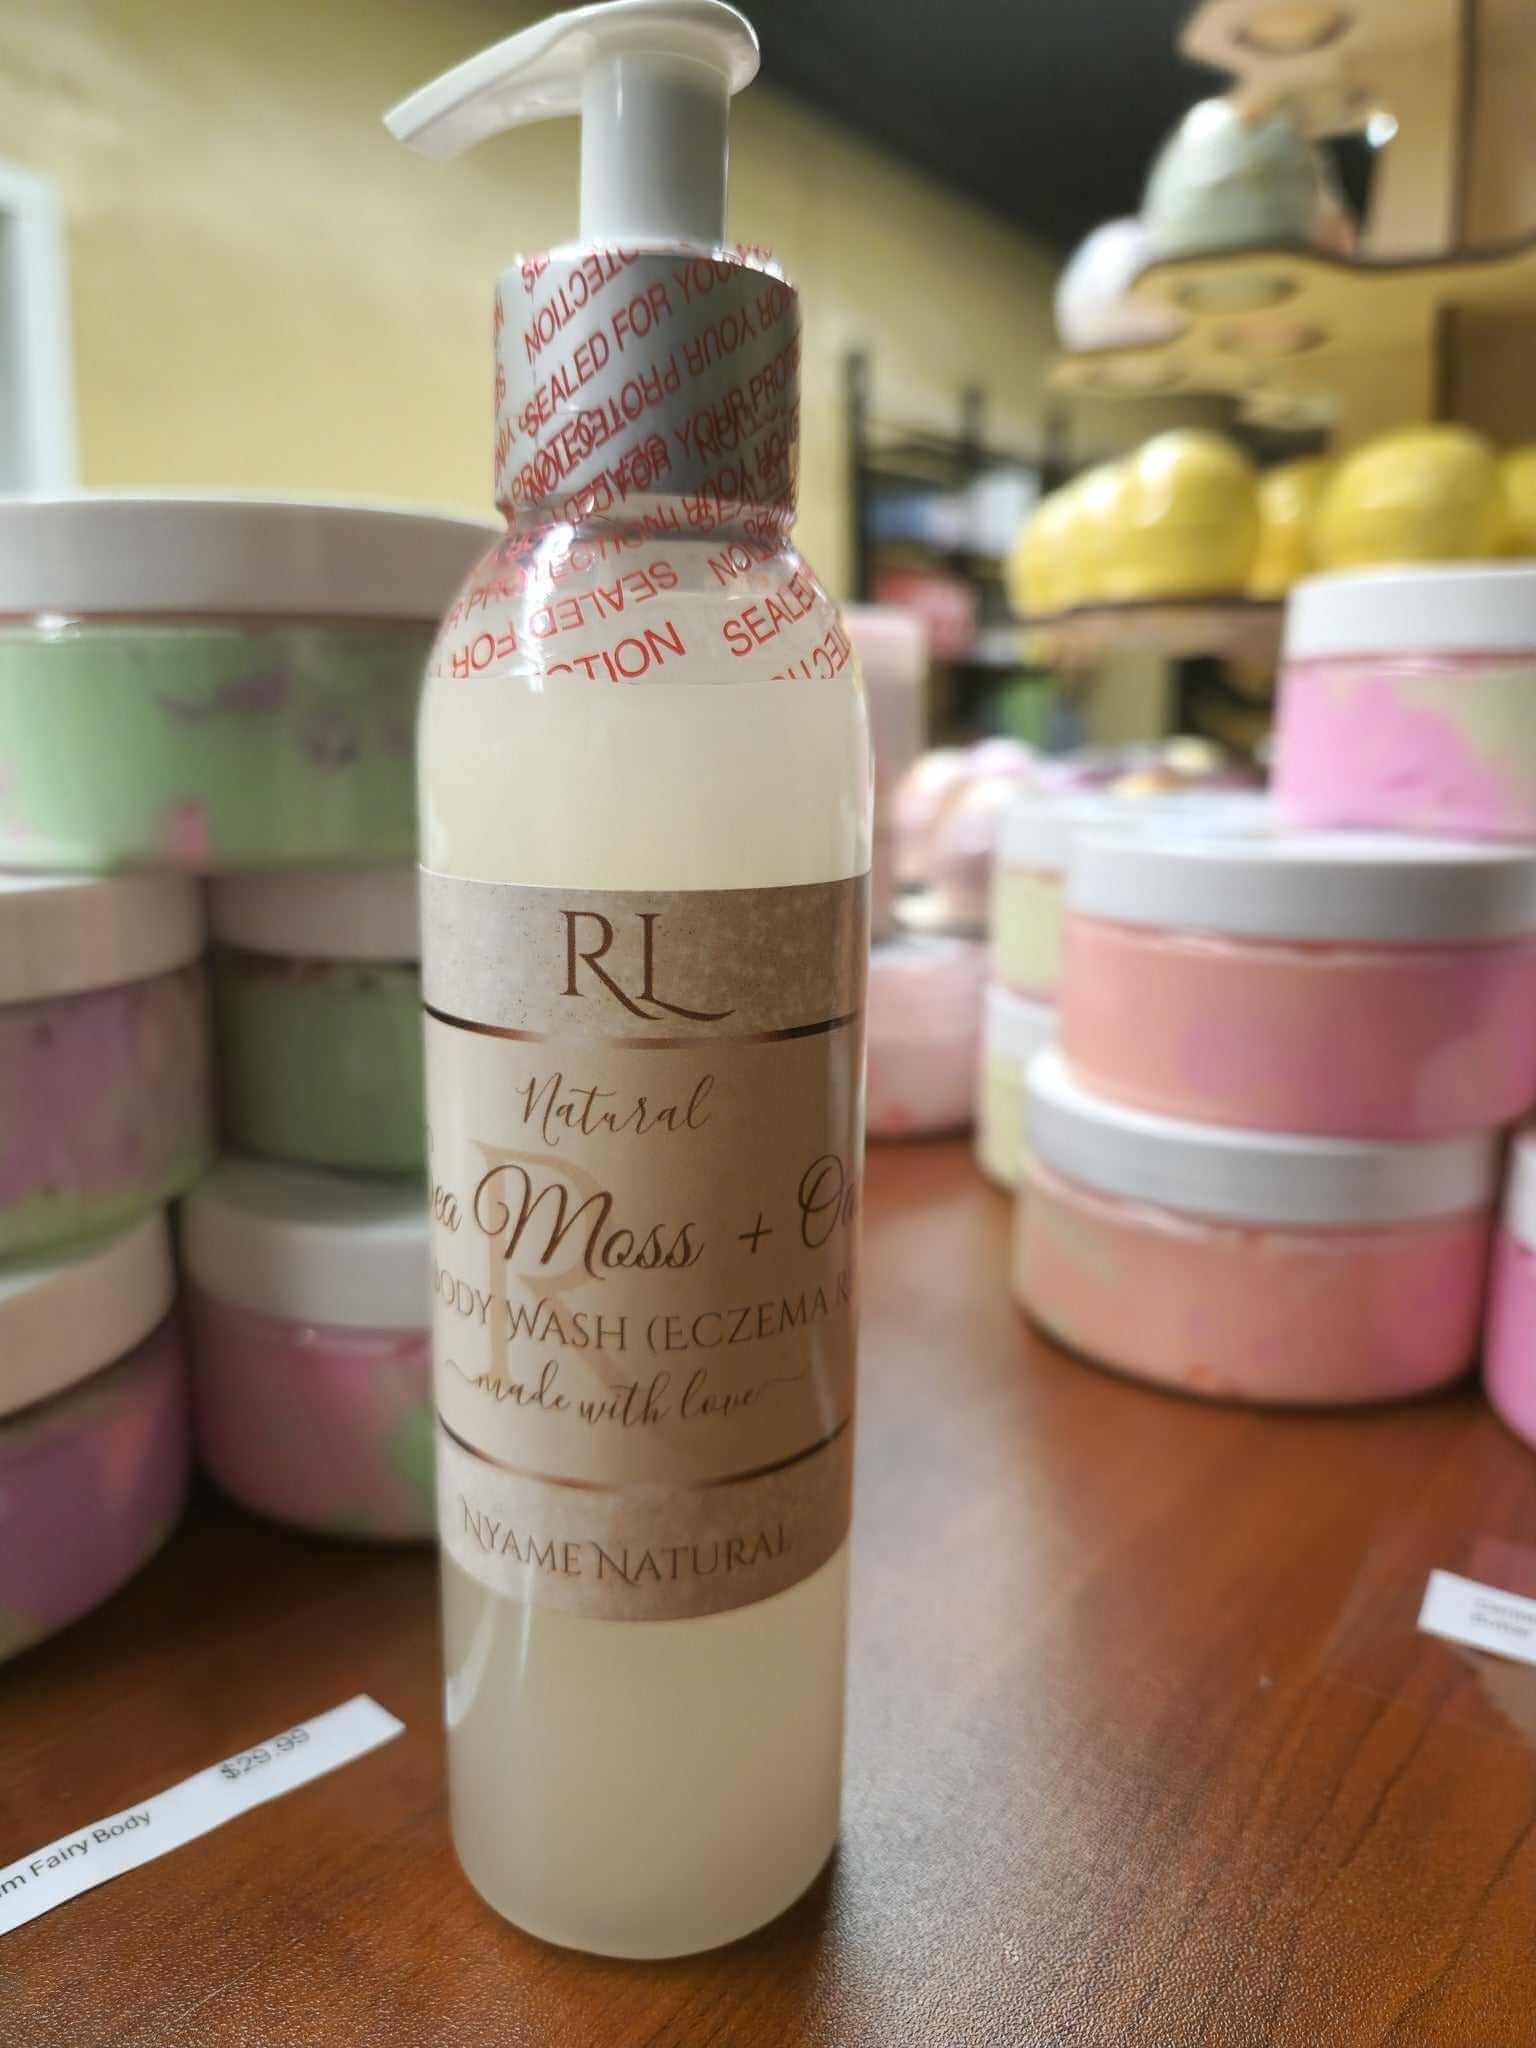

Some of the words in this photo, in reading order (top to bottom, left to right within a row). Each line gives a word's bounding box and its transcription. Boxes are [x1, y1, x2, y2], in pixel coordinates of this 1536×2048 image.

[612, 283, 672, 353] FOR
[515, 1071, 716, 1146] Natural
[431, 1176, 463, 1233] ea
[473, 1163, 706, 1282] Moss
[505, 1297, 626, 1352] WASH
[646, 1285, 829, 1353] (ECZEMA
[466, 1359, 570, 1412] made
[578, 1368, 673, 1428] with
[680, 1367, 765, 1420] love
[459, 1494, 583, 1577] NYAME
[0, 1873, 27, 1899] m
[29, 1838, 89, 1878] Fairy
[92, 1811, 151, 1844] Body
[219, 1727, 312, 1780] $29.99
